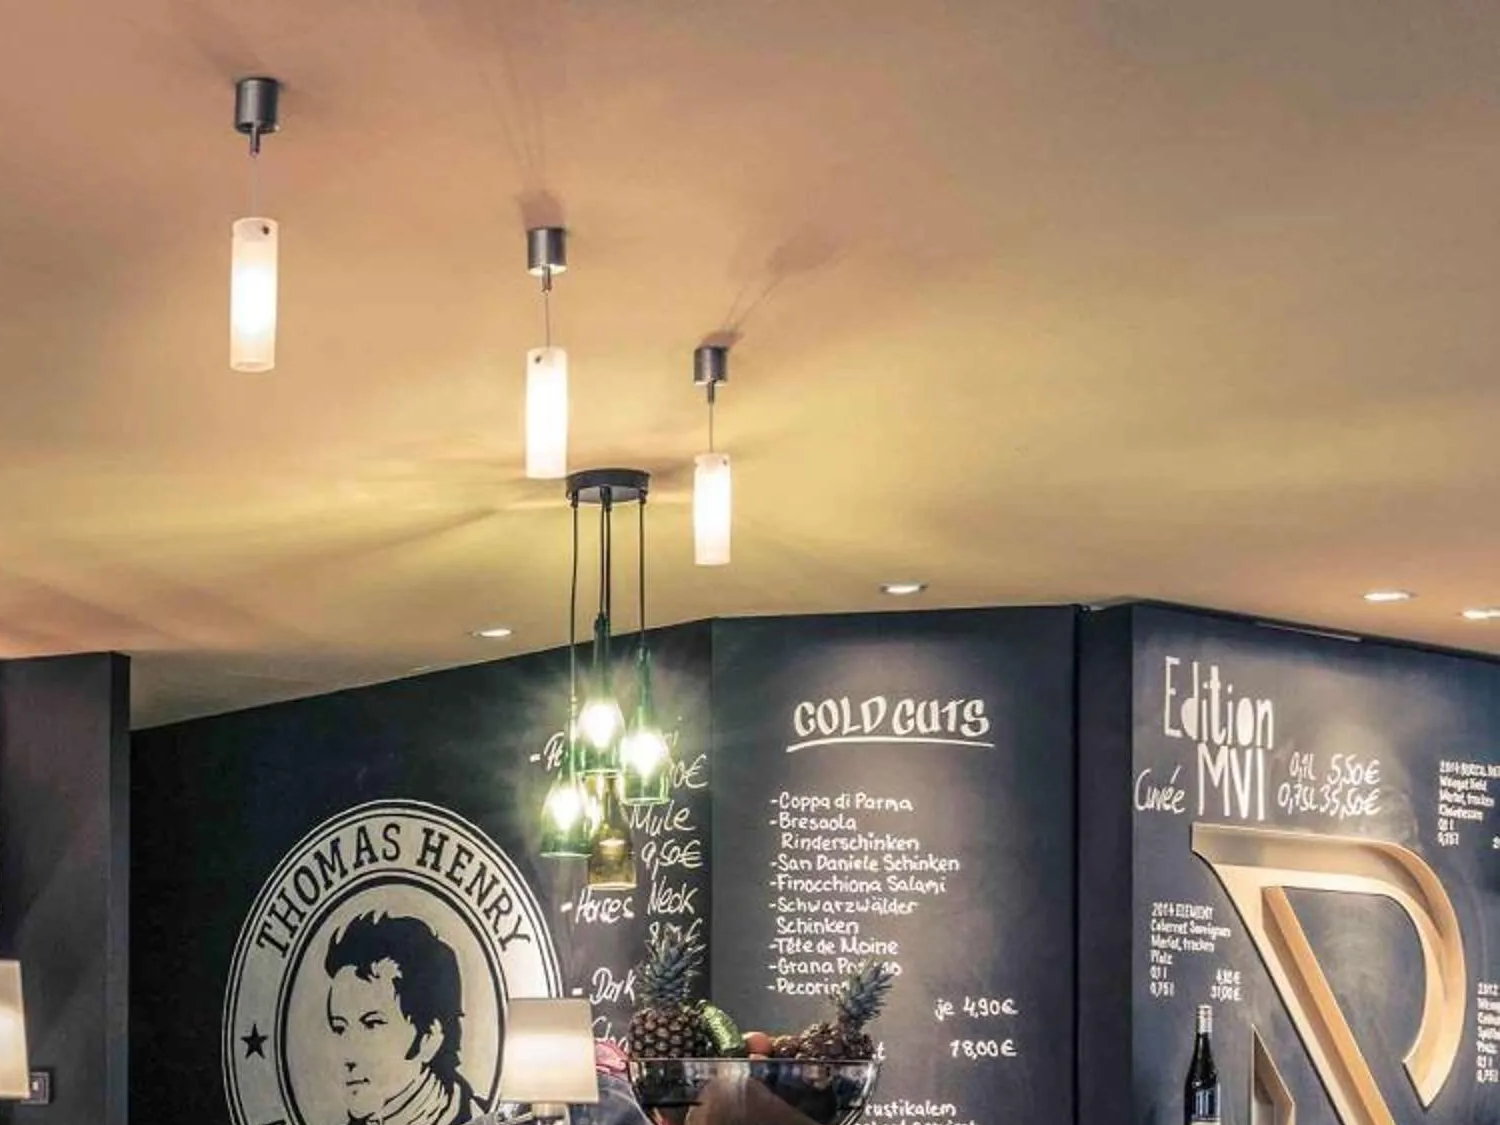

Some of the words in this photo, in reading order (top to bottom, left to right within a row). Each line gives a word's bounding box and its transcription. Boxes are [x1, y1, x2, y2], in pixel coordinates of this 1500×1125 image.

[1164, 656, 1274, 750] Edition
[793, 696, 888, 736] COLD
[892, 697, 991, 736] CUTS
[1134, 765, 1186, 813] Cuvée
[1198, 743, 1265, 820] MVI
[835, 793, 851, 809] di
[855, 793, 913, 812] Parma
[781, 833, 921, 851] Rinderschinken
[884, 854, 961, 873] Schinken
[256, 823, 401, 959] THOMAS
[416, 827, 532, 955] HENRY
[887, 875, 947, 894] Salami
[776, 917, 860, 935] Schinken
[816, 938, 836, 954] de
[841, 937, 900, 955] Moine
[934, 998, 956, 1021] je
[963, 995, 1019, 1019] 4,90€
[865, 1099, 957, 1118] rustikalem
